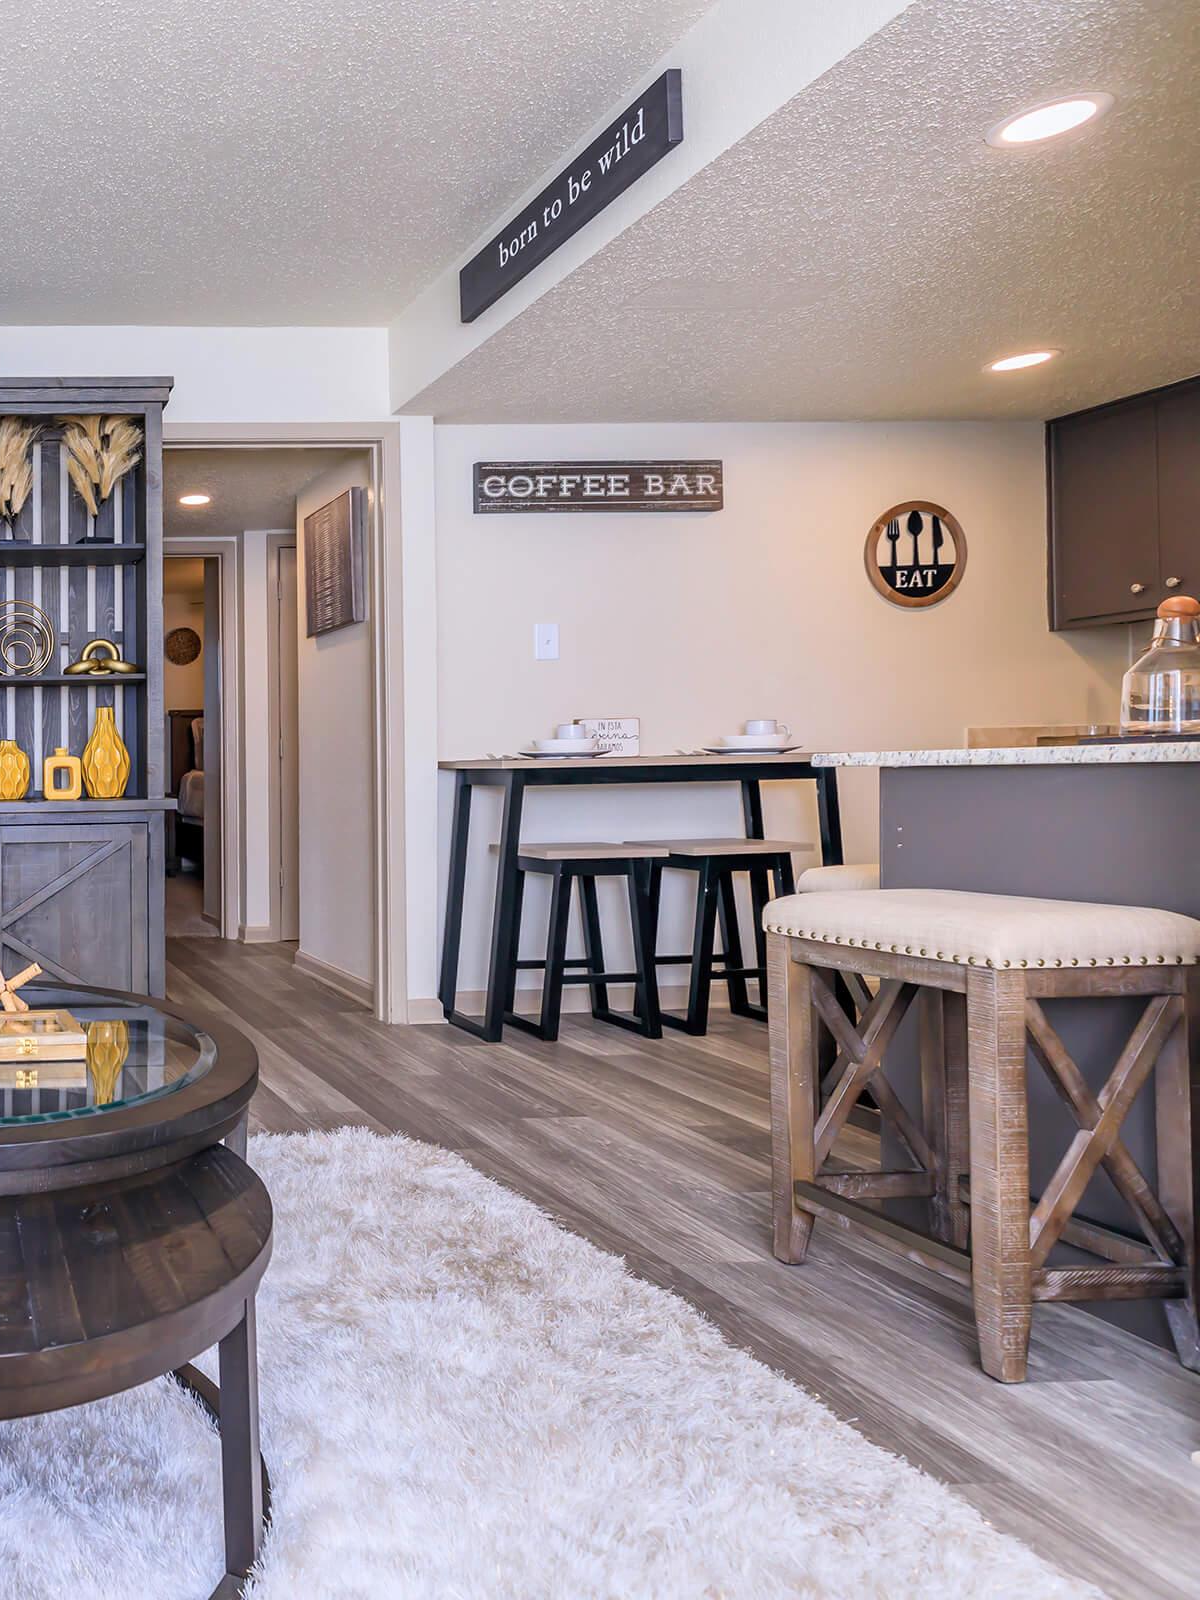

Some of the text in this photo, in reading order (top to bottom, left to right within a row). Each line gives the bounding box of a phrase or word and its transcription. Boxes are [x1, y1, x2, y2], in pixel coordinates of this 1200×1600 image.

[499, 108, 645, 268] born to be wild
[483, 474, 718, 498] COFFEE BAR
[895, 569, 937, 588] EAT
